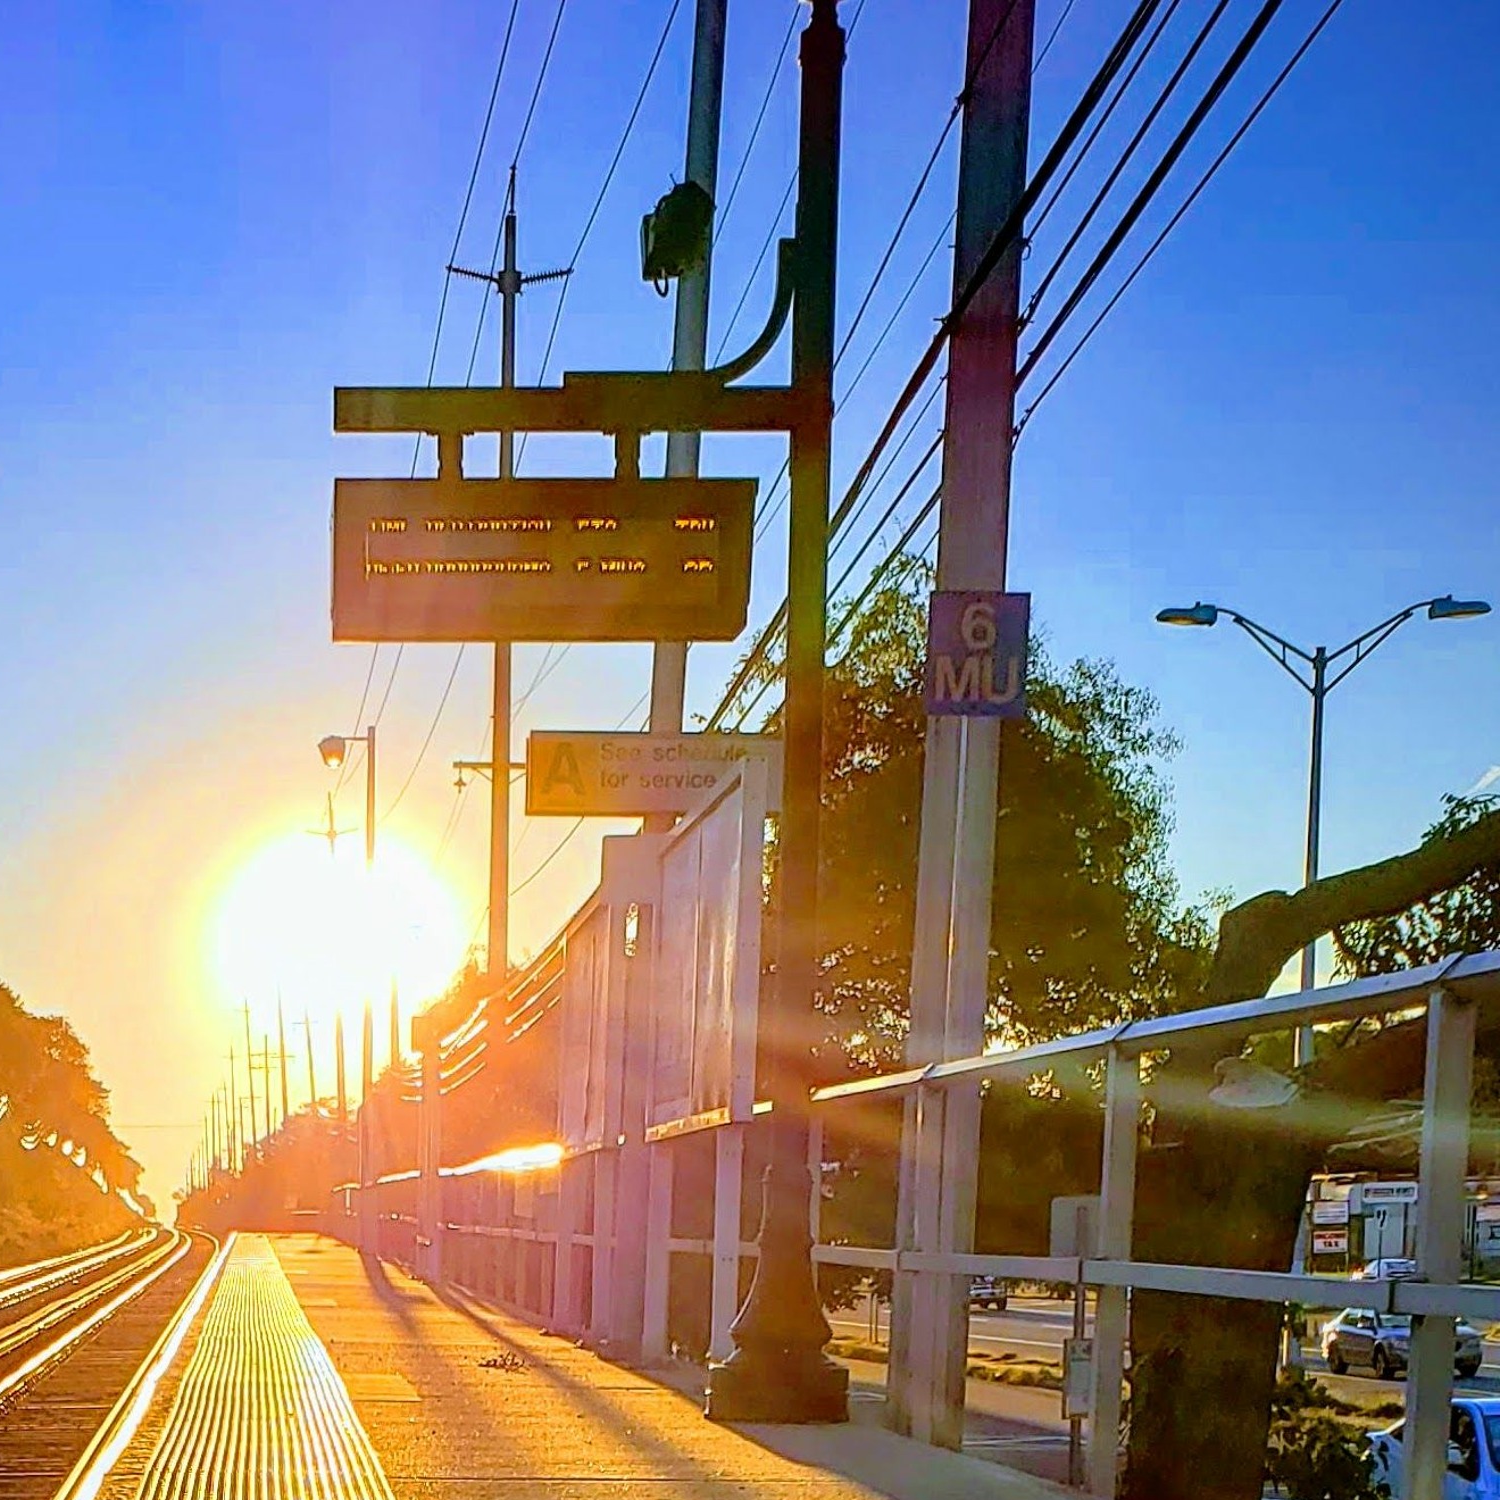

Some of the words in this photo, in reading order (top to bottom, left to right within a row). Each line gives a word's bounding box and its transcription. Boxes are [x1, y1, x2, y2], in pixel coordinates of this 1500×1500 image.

[961, 601, 997, 651] 6
[933, 653, 1021, 704] MU
[541, 741, 585, 796] A
[600, 742, 642, 761] See
[599, 770, 630, 789] for
[639, 770, 717, 789] service
